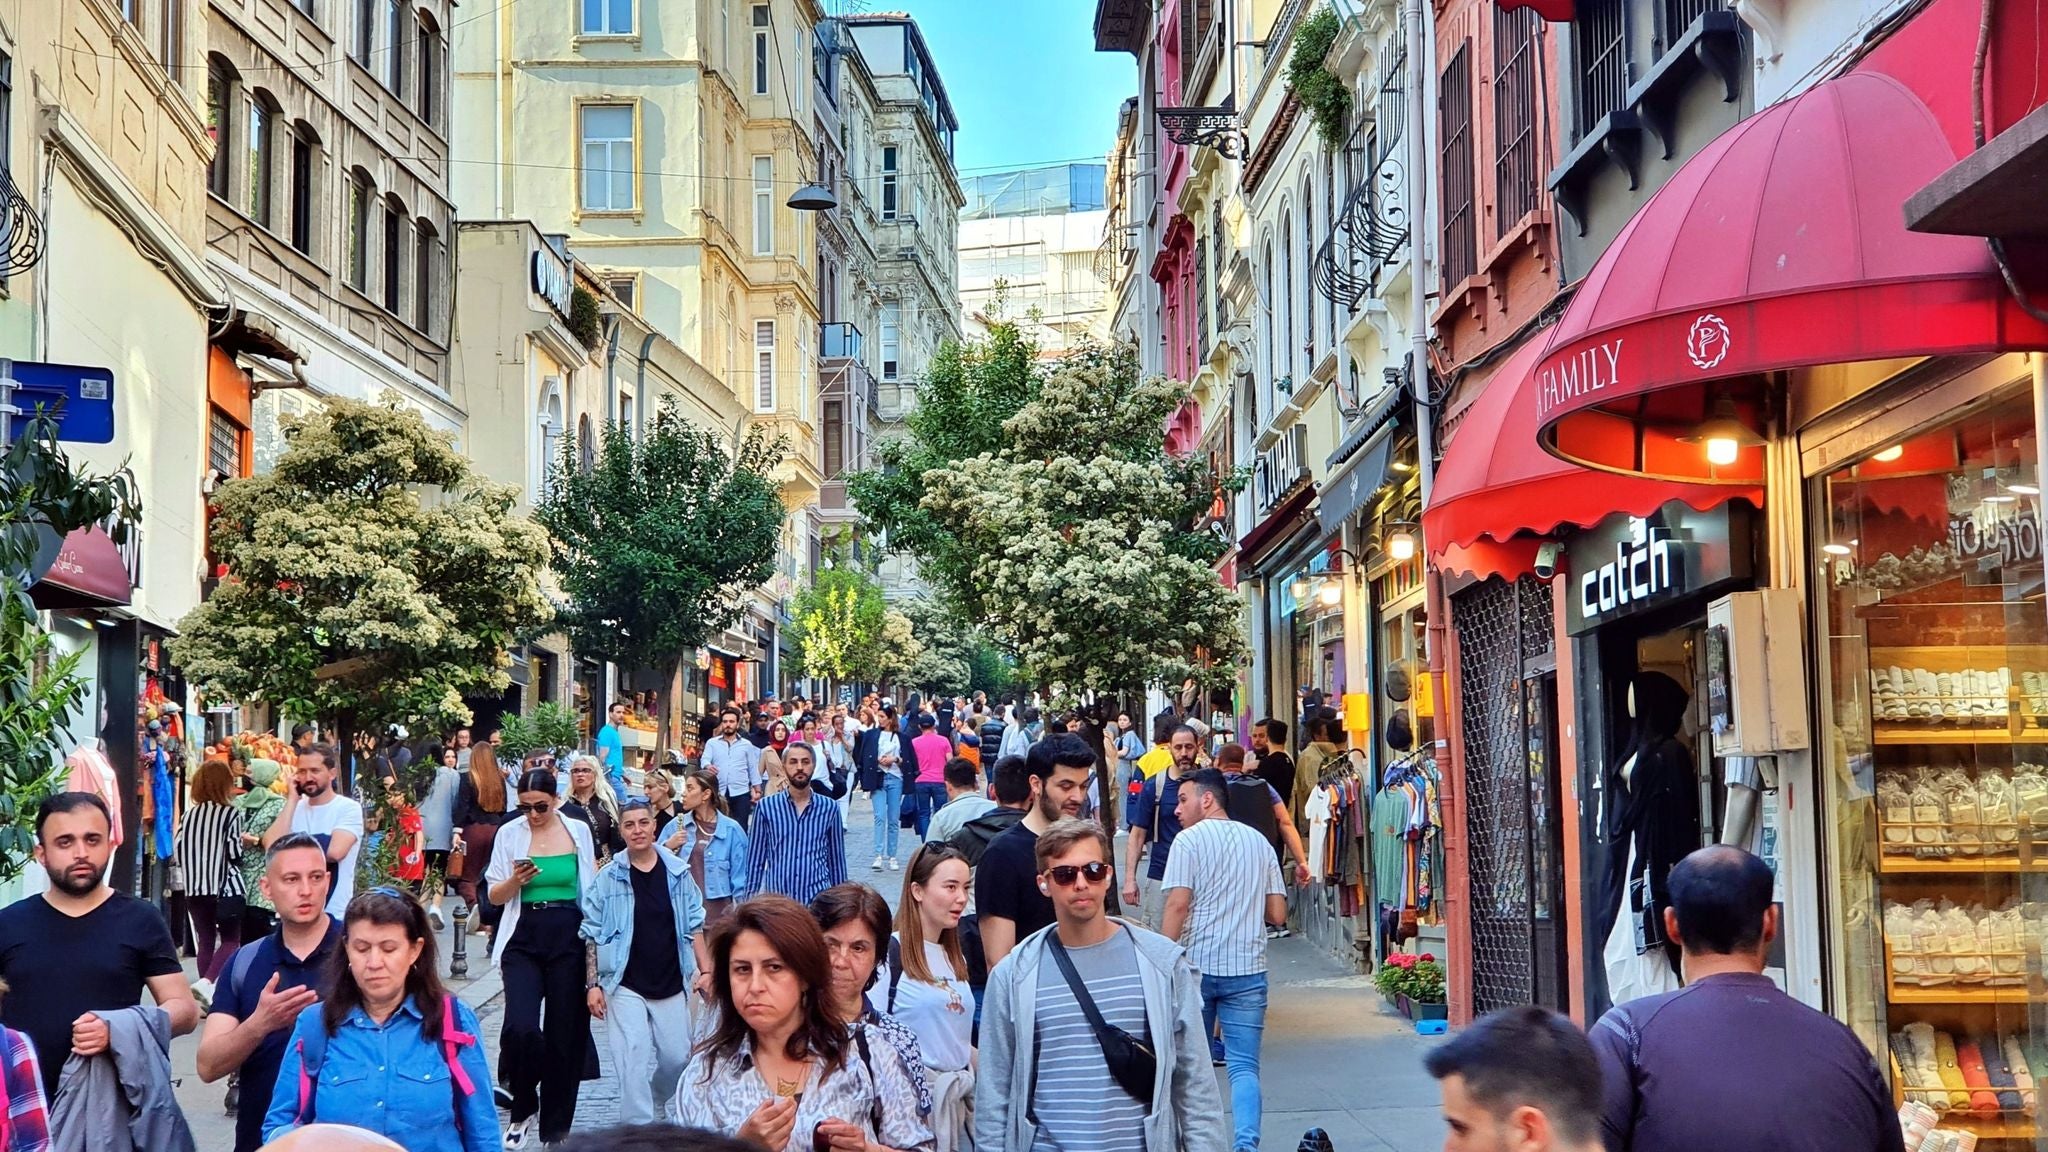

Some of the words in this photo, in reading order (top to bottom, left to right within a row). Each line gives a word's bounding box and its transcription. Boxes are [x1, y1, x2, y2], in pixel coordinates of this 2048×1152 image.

[1543, 339, 1623, 413] FAMILY
[1266, 424, 1301, 507] ZUHAL
[1582, 527, 1669, 618] catch
